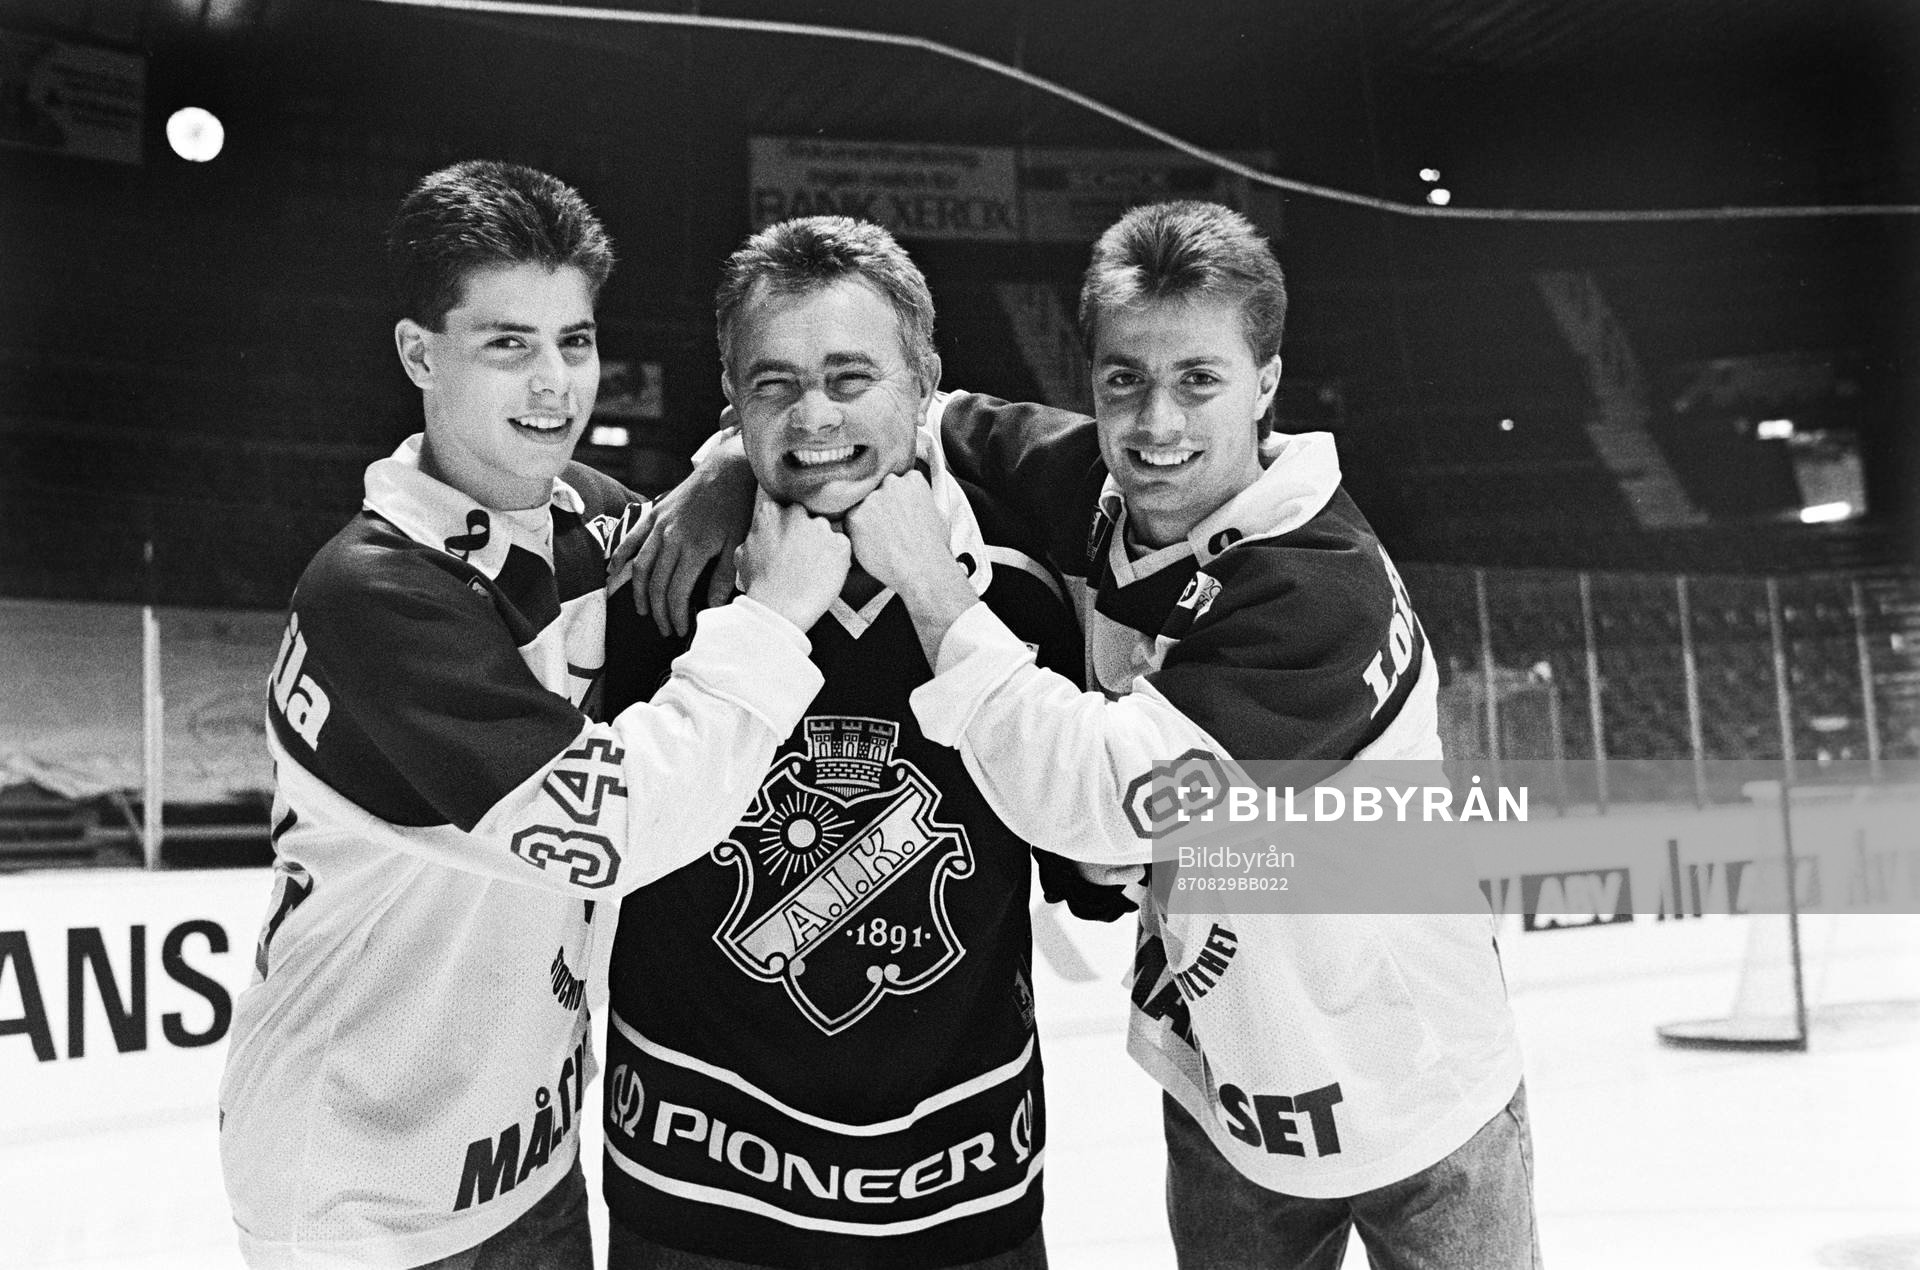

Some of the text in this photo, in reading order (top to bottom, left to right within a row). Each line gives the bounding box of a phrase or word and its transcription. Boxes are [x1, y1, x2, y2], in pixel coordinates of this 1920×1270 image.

[510, 738, 629, 890] 34
[1122, 747, 1231, 840] 8
[652, 1100, 997, 1204] PIONEER
[1219, 1081, 1344, 1159] SET
